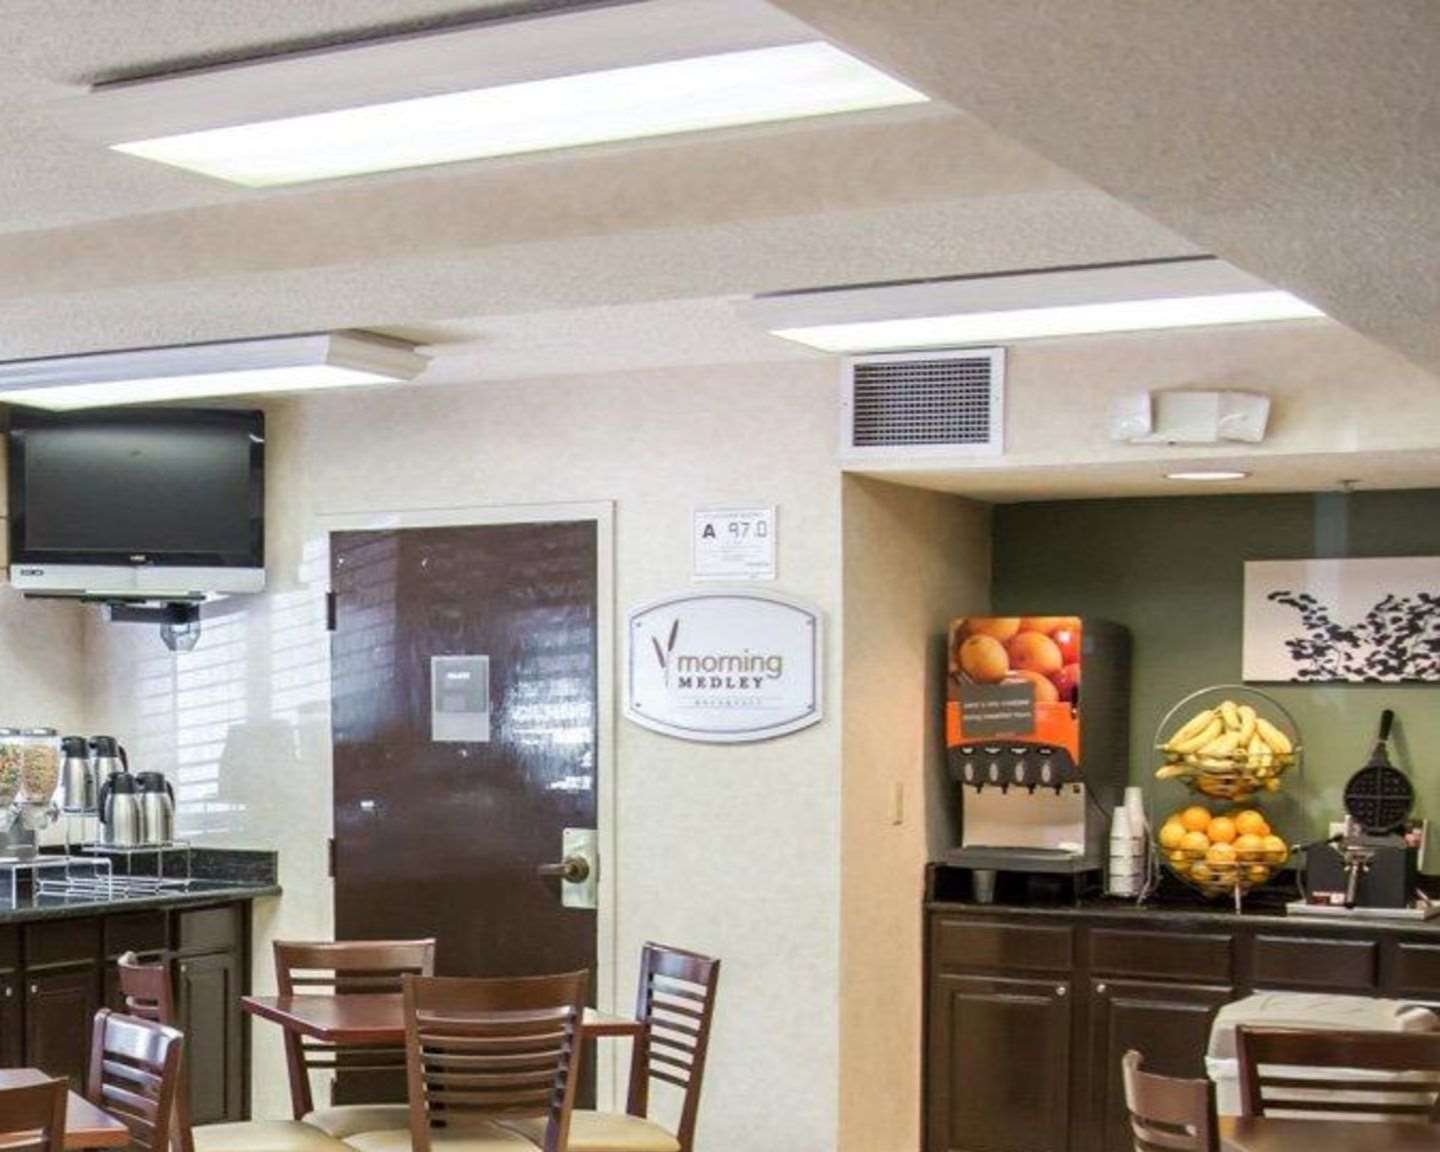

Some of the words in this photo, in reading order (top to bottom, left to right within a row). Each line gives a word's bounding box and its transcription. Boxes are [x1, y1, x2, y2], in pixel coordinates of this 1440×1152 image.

[702, 523, 716, 539] A
[677, 648, 783, 680] morning
[678, 676, 763, 689] MEDLEY
